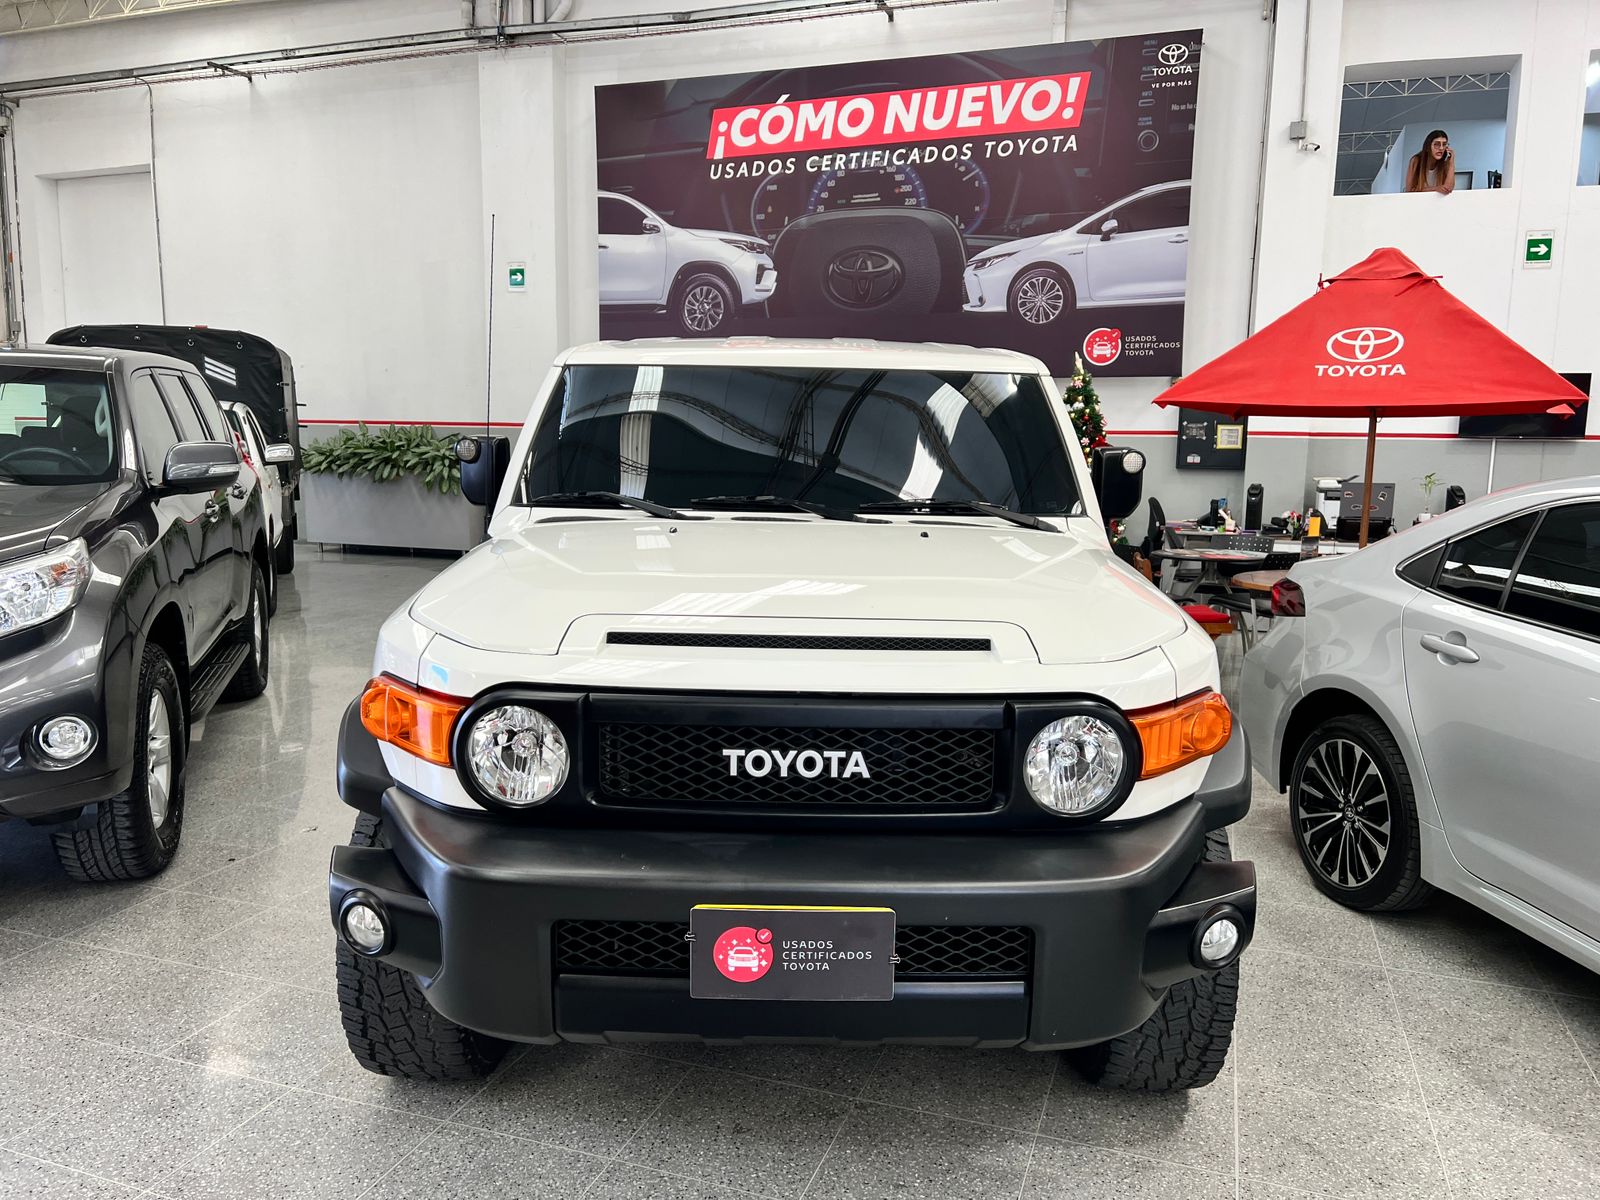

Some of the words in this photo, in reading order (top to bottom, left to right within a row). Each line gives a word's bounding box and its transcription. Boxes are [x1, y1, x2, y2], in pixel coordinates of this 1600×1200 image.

[1152, 65, 1193, 76] TOYOTA
[1178, 79, 1192, 87] MÁS
[713, 93, 875, 160] ¡CÓMO
[883, 76, 1082, 135] NUEVO!
[709, 158, 796, 180] USADOS
[805, 142, 974, 173] CERTIFICADOS
[984, 134, 1078, 159] TOYOTA
[820, 191, 829, 199] 40
[904, 198, 917, 206] 220
[1124, 341, 1181, 349] CERTIFICADOS
[1314, 363, 1407, 377] TOYOTA
[722, 749, 871, 779] TOYOTA
[782, 940, 834, 949] USADOS
[782, 951, 873, 960] CERTIFICADOS
[782, 961, 830, 971] TOYOTA
